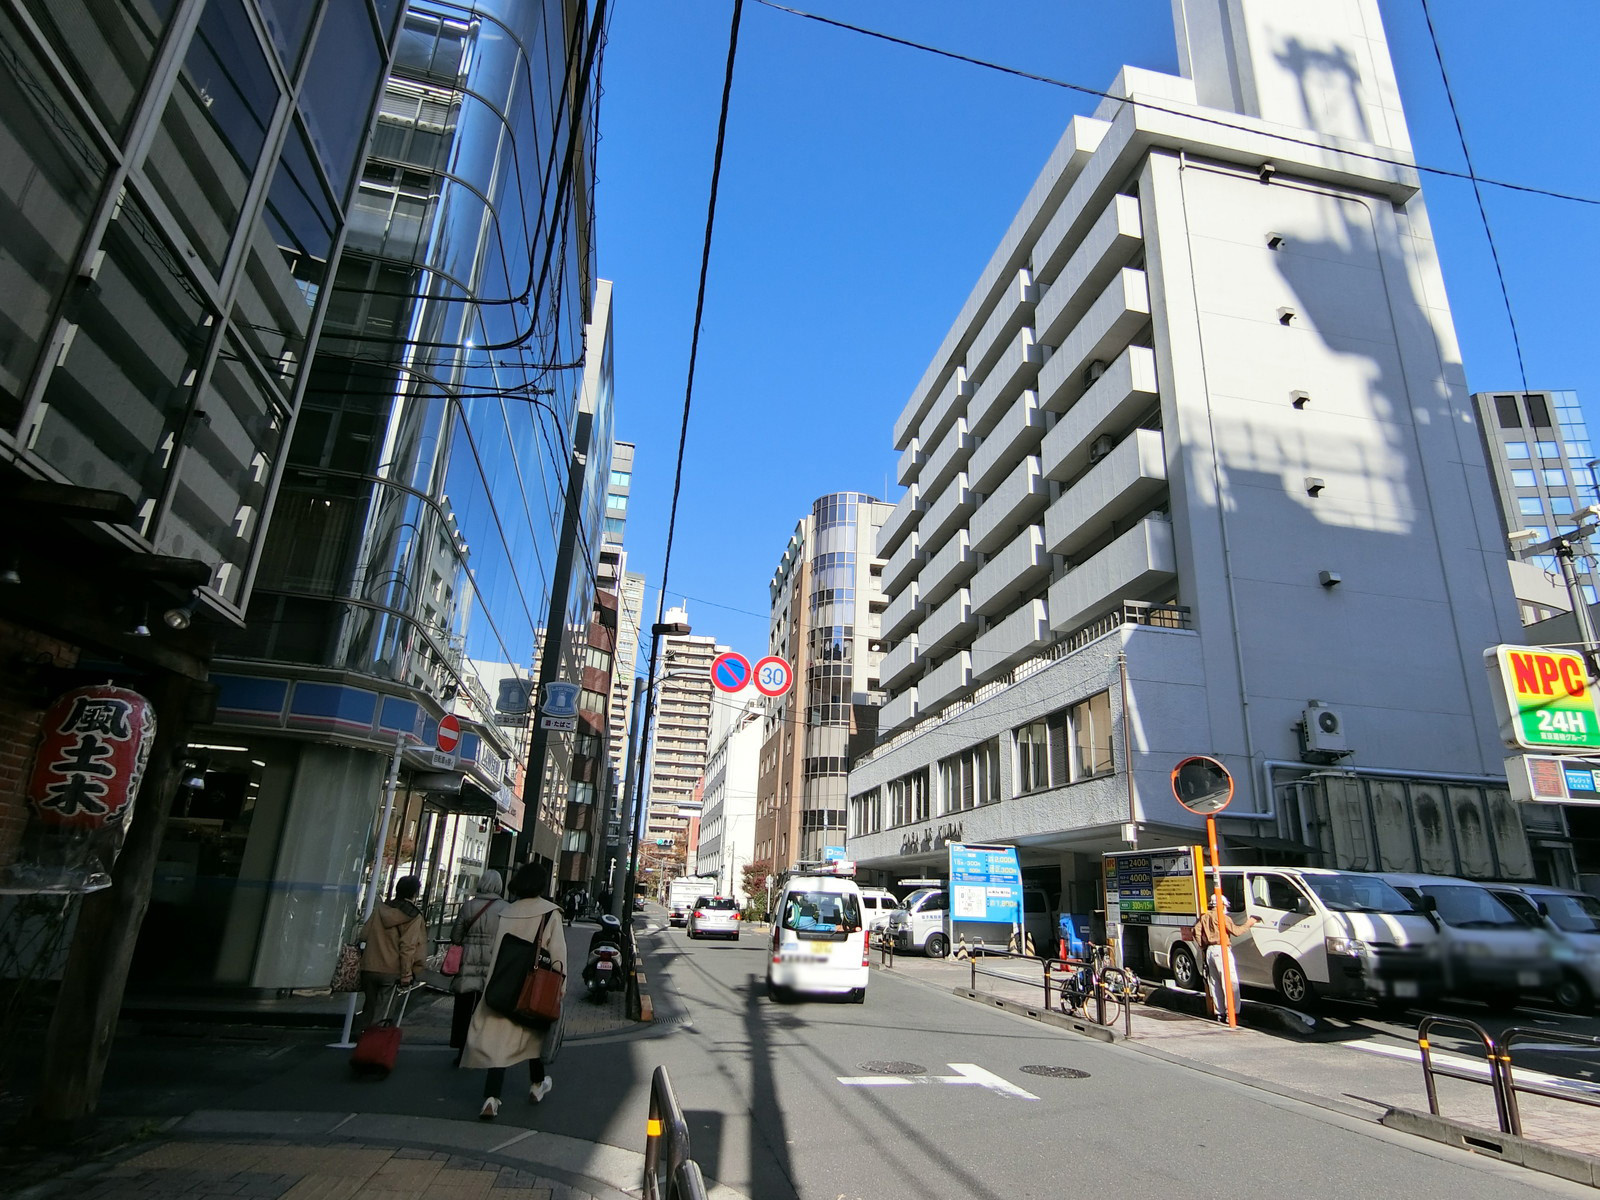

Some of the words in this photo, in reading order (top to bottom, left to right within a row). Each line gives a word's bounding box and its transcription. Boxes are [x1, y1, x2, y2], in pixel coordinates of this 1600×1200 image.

[762, 667, 783, 686] 30
[1510, 653, 1584, 698] NPC
[1536, 710, 1587, 733] 24H
